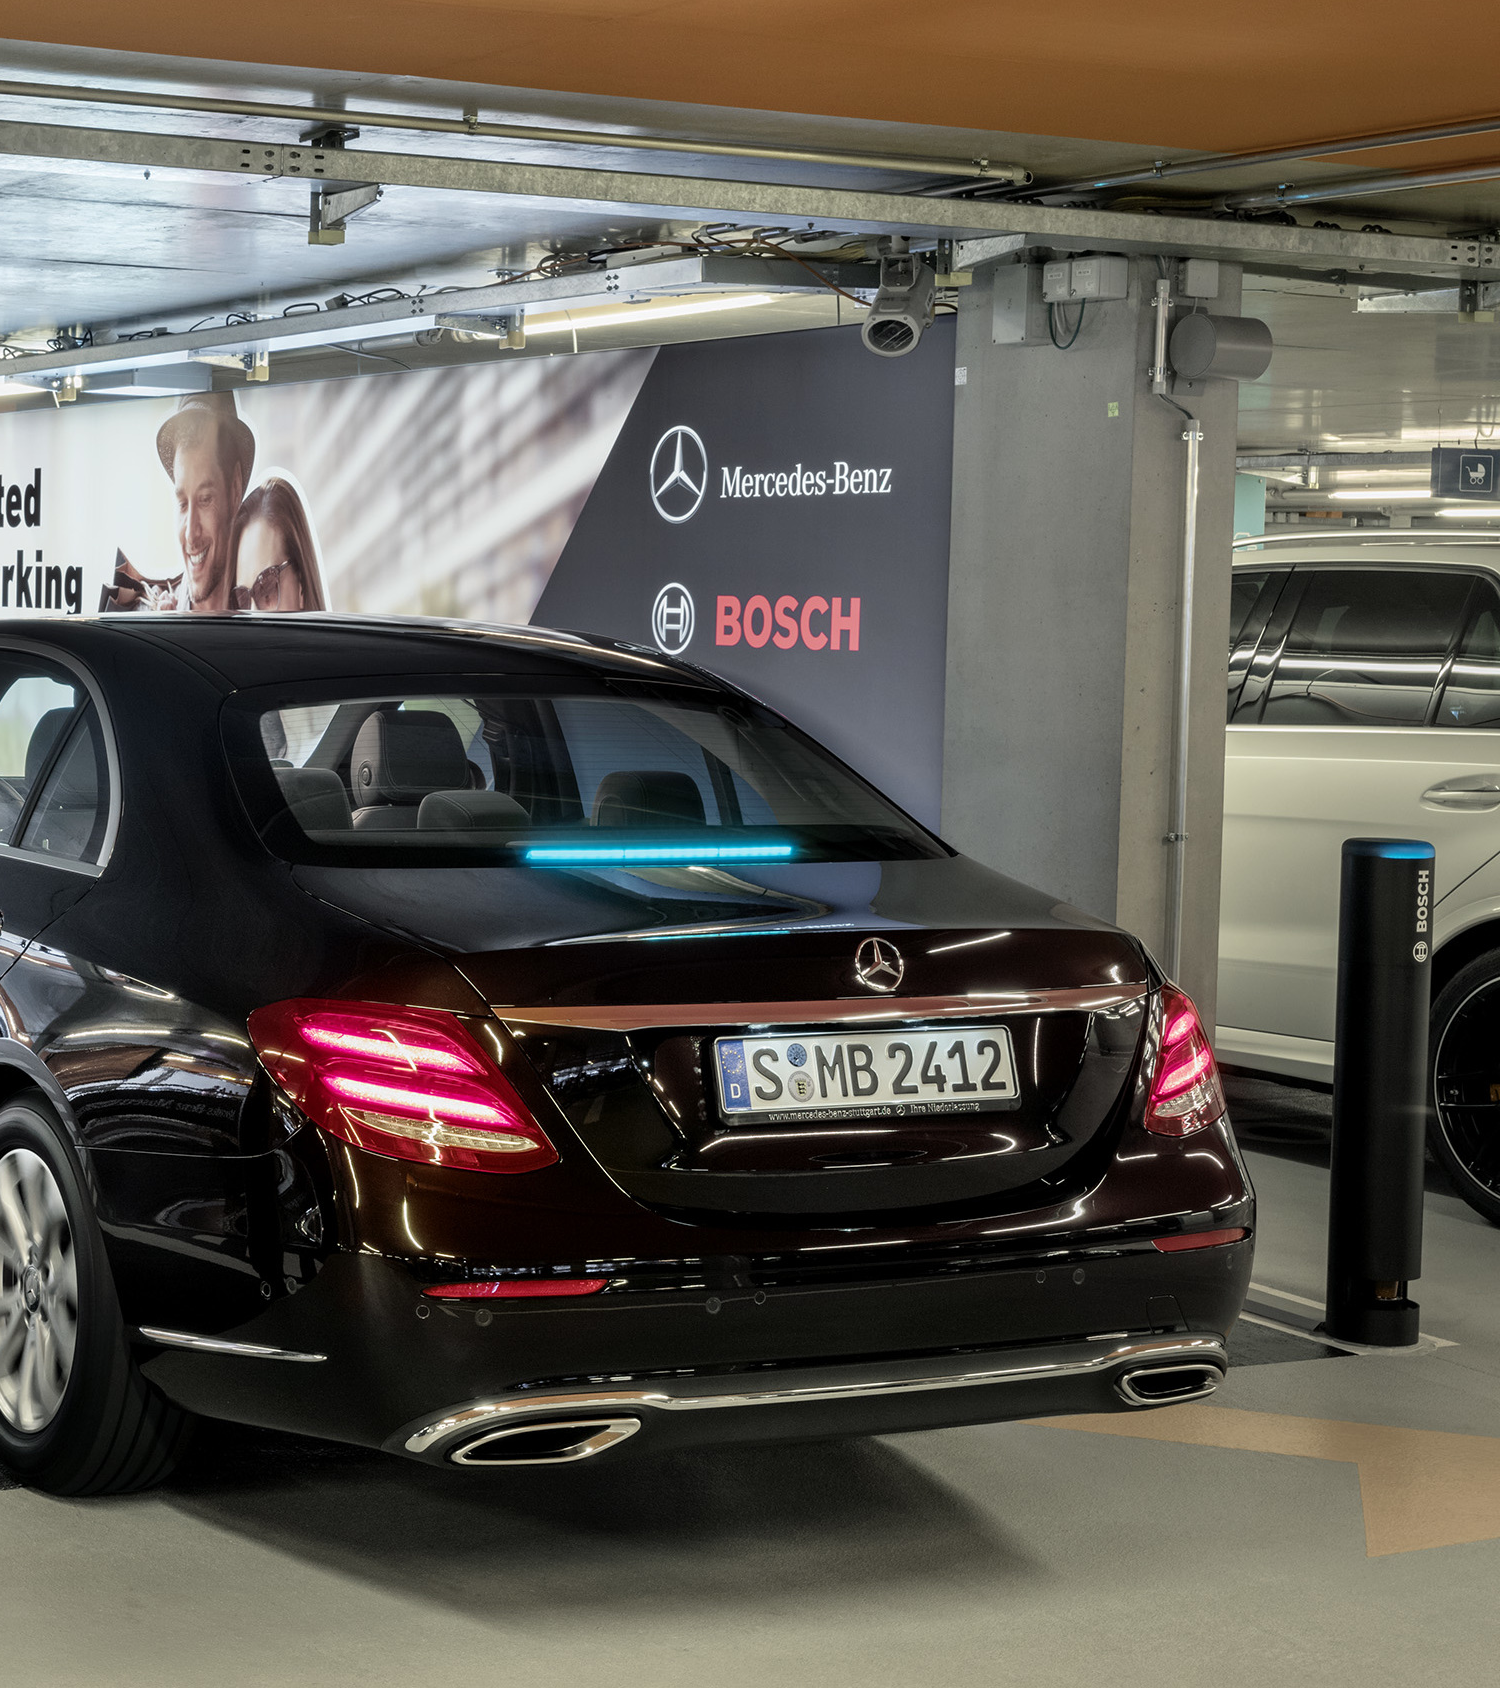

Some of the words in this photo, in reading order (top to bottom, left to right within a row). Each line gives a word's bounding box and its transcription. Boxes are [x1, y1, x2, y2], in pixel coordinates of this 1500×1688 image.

[719, 461, 893, 499] Mercedes-Benz
[715, 594, 861, 651] BOSCH
[1416, 869, 1430, 933] BOSCH
[730, 1083, 742, 1099] D
[752, 1047, 784, 1101] S
[814, 1043, 879, 1098] MB
[887, 1039, 1007, 1095] 2412
[768, 1105, 892, 1121] www.mercedes-benz-stuttgart.de
[910, 1104, 926, 1113] Ihre
